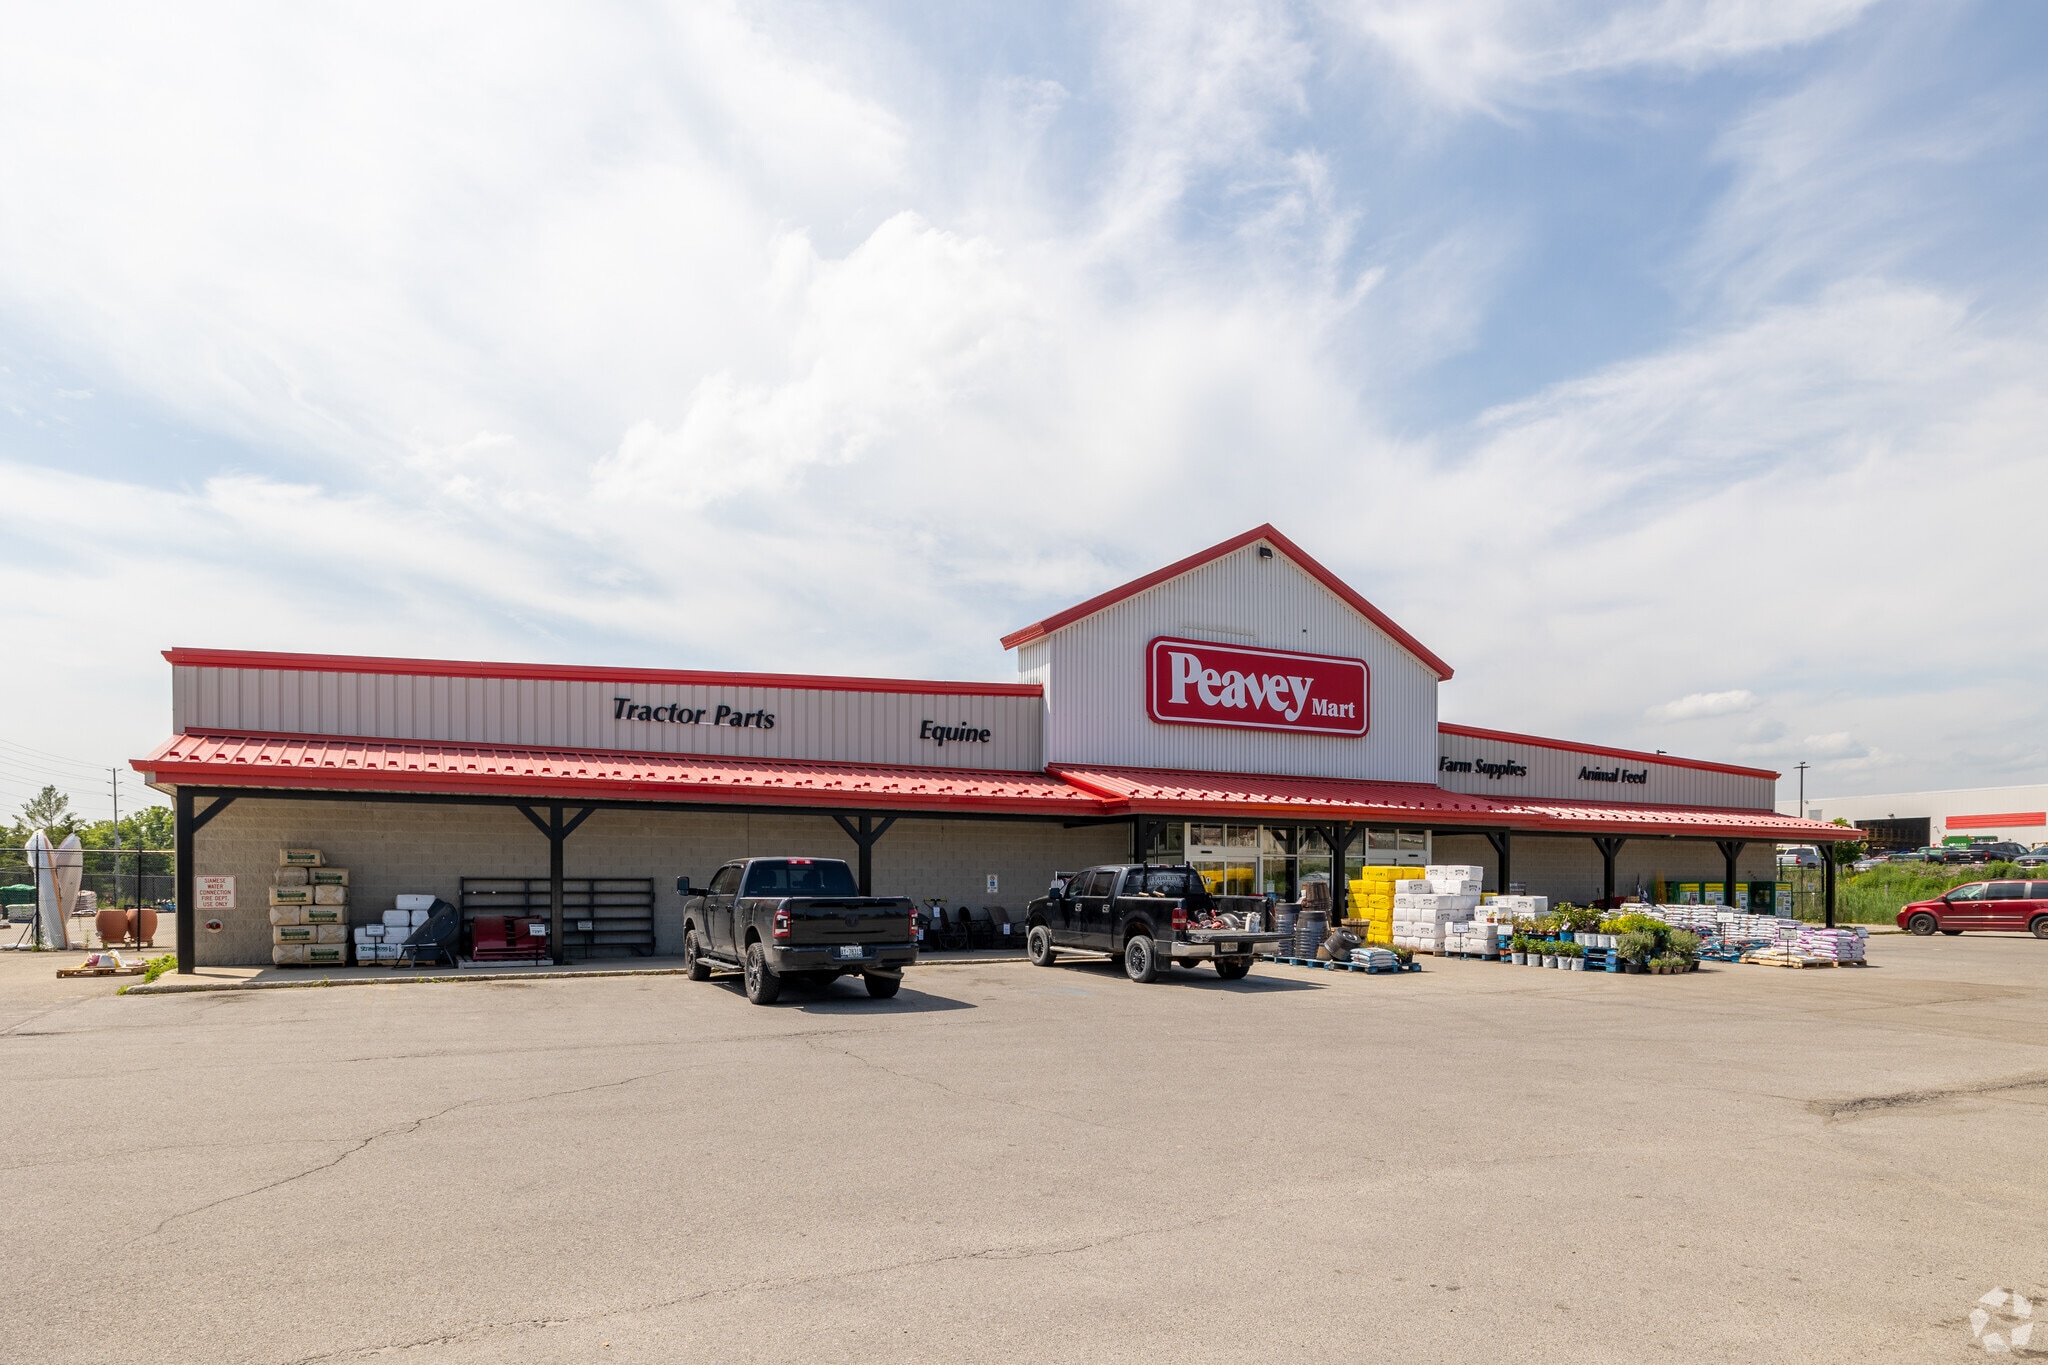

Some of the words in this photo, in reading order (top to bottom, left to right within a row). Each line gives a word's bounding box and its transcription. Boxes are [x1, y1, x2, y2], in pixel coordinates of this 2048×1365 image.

[1168, 651, 1314, 722] Peavey
[1312, 698, 1356, 719] Mart
[613, 697, 706, 725] Tractor
[714, 705, 775, 729] Parts
[920, 720, 991, 747] Equine
[1439, 756, 1472, 773] Farm
[1475, 758, 1527, 780] Supplies
[1578, 766, 1620, 783] Animal
[1621, 769, 1648, 785] Feed
